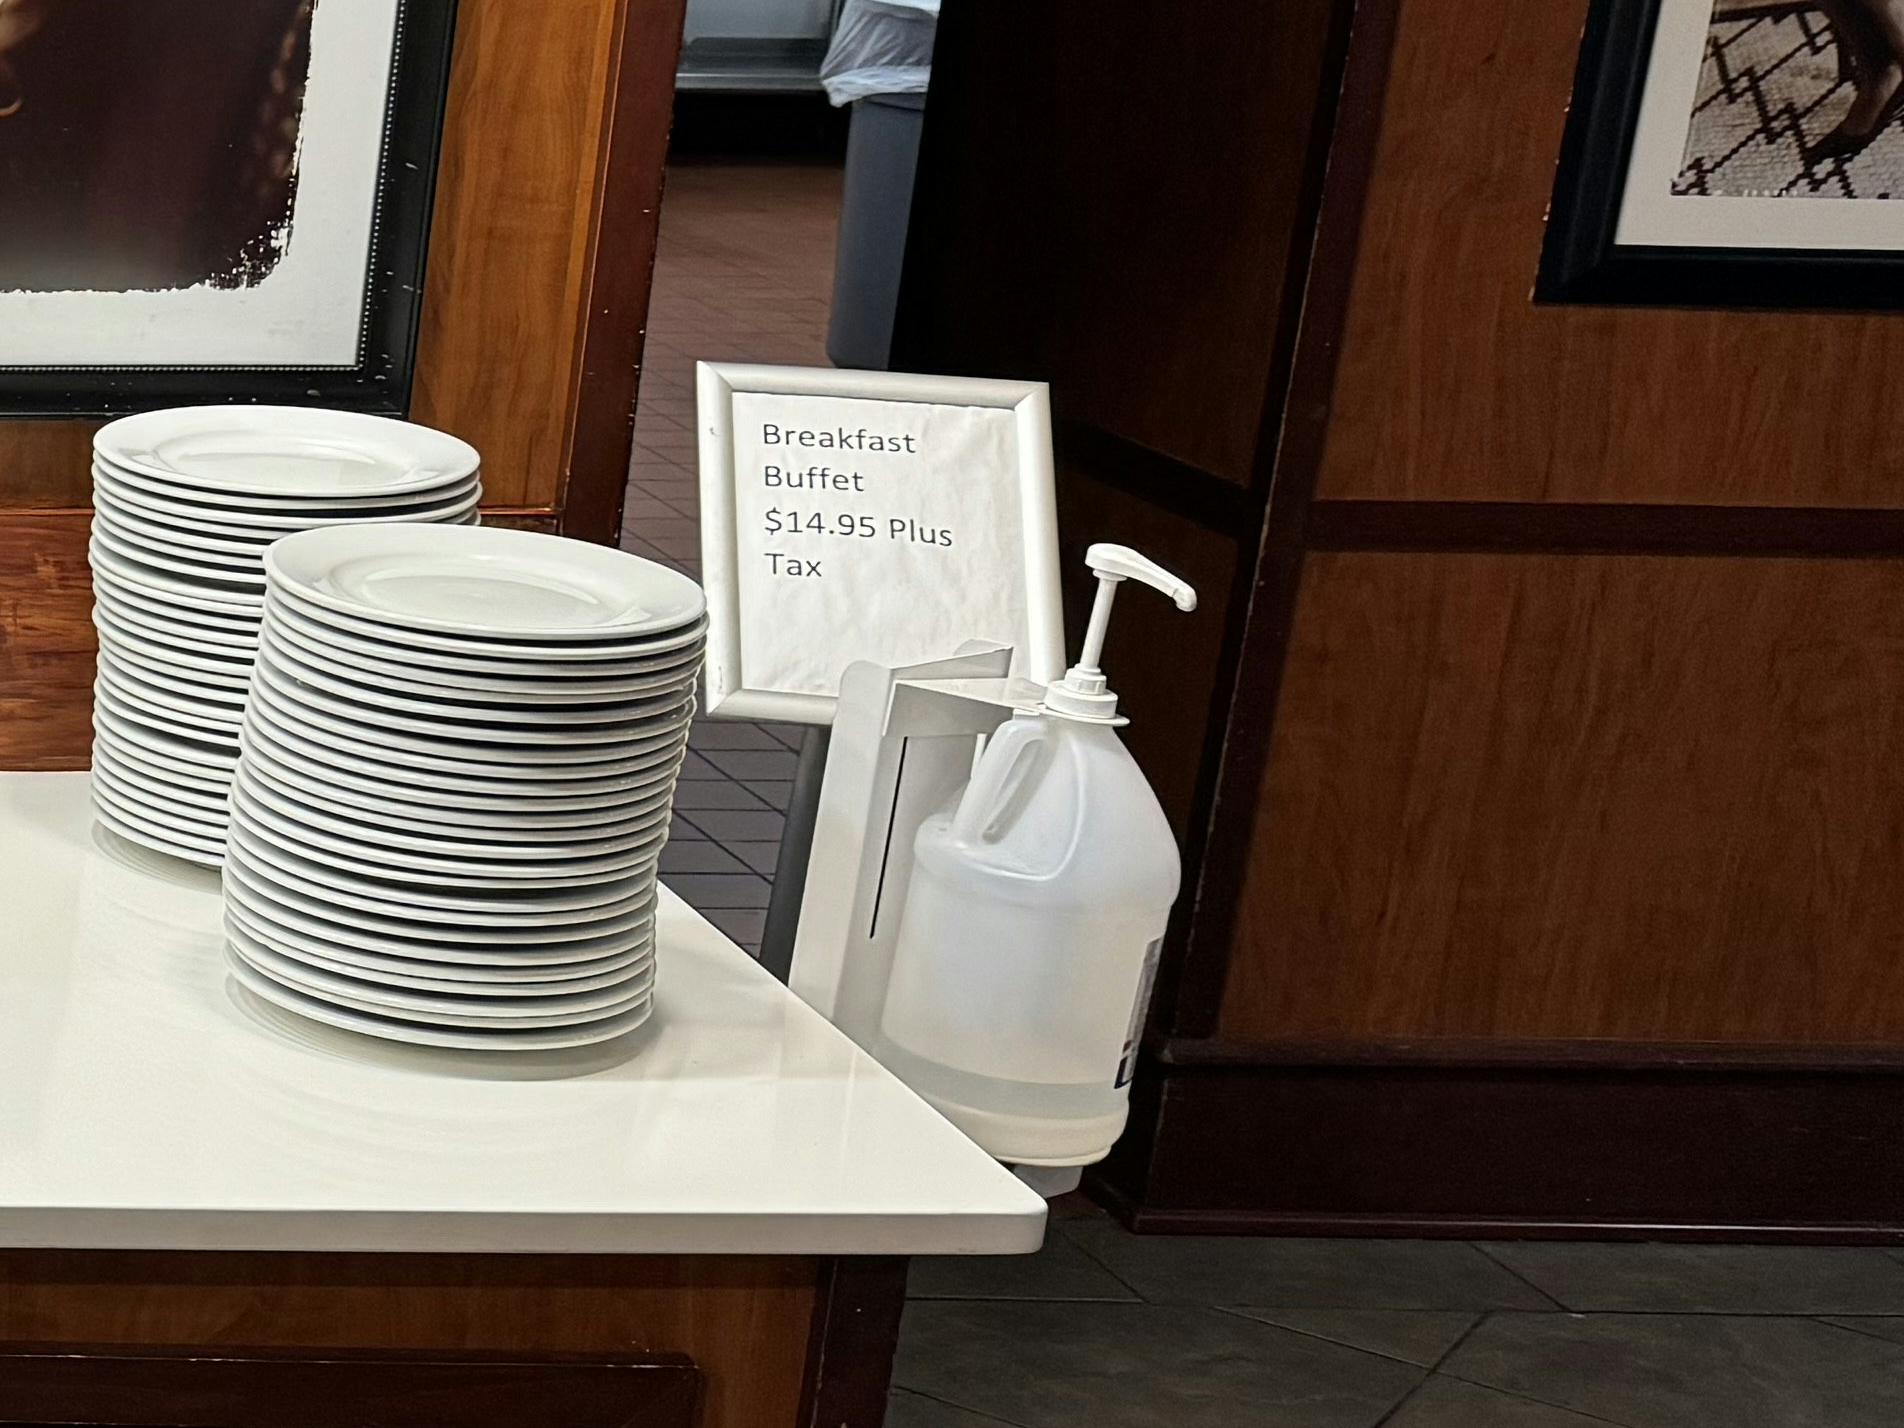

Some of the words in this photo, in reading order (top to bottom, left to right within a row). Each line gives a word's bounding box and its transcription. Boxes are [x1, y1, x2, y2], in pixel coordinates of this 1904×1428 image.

[762, 423, 917, 454] Breakfast
[763, 465, 865, 492] Buffet
[764, 507, 877, 538] $14.95
[889, 518, 953, 547] Plus
[764, 552, 823, 577] Tax
